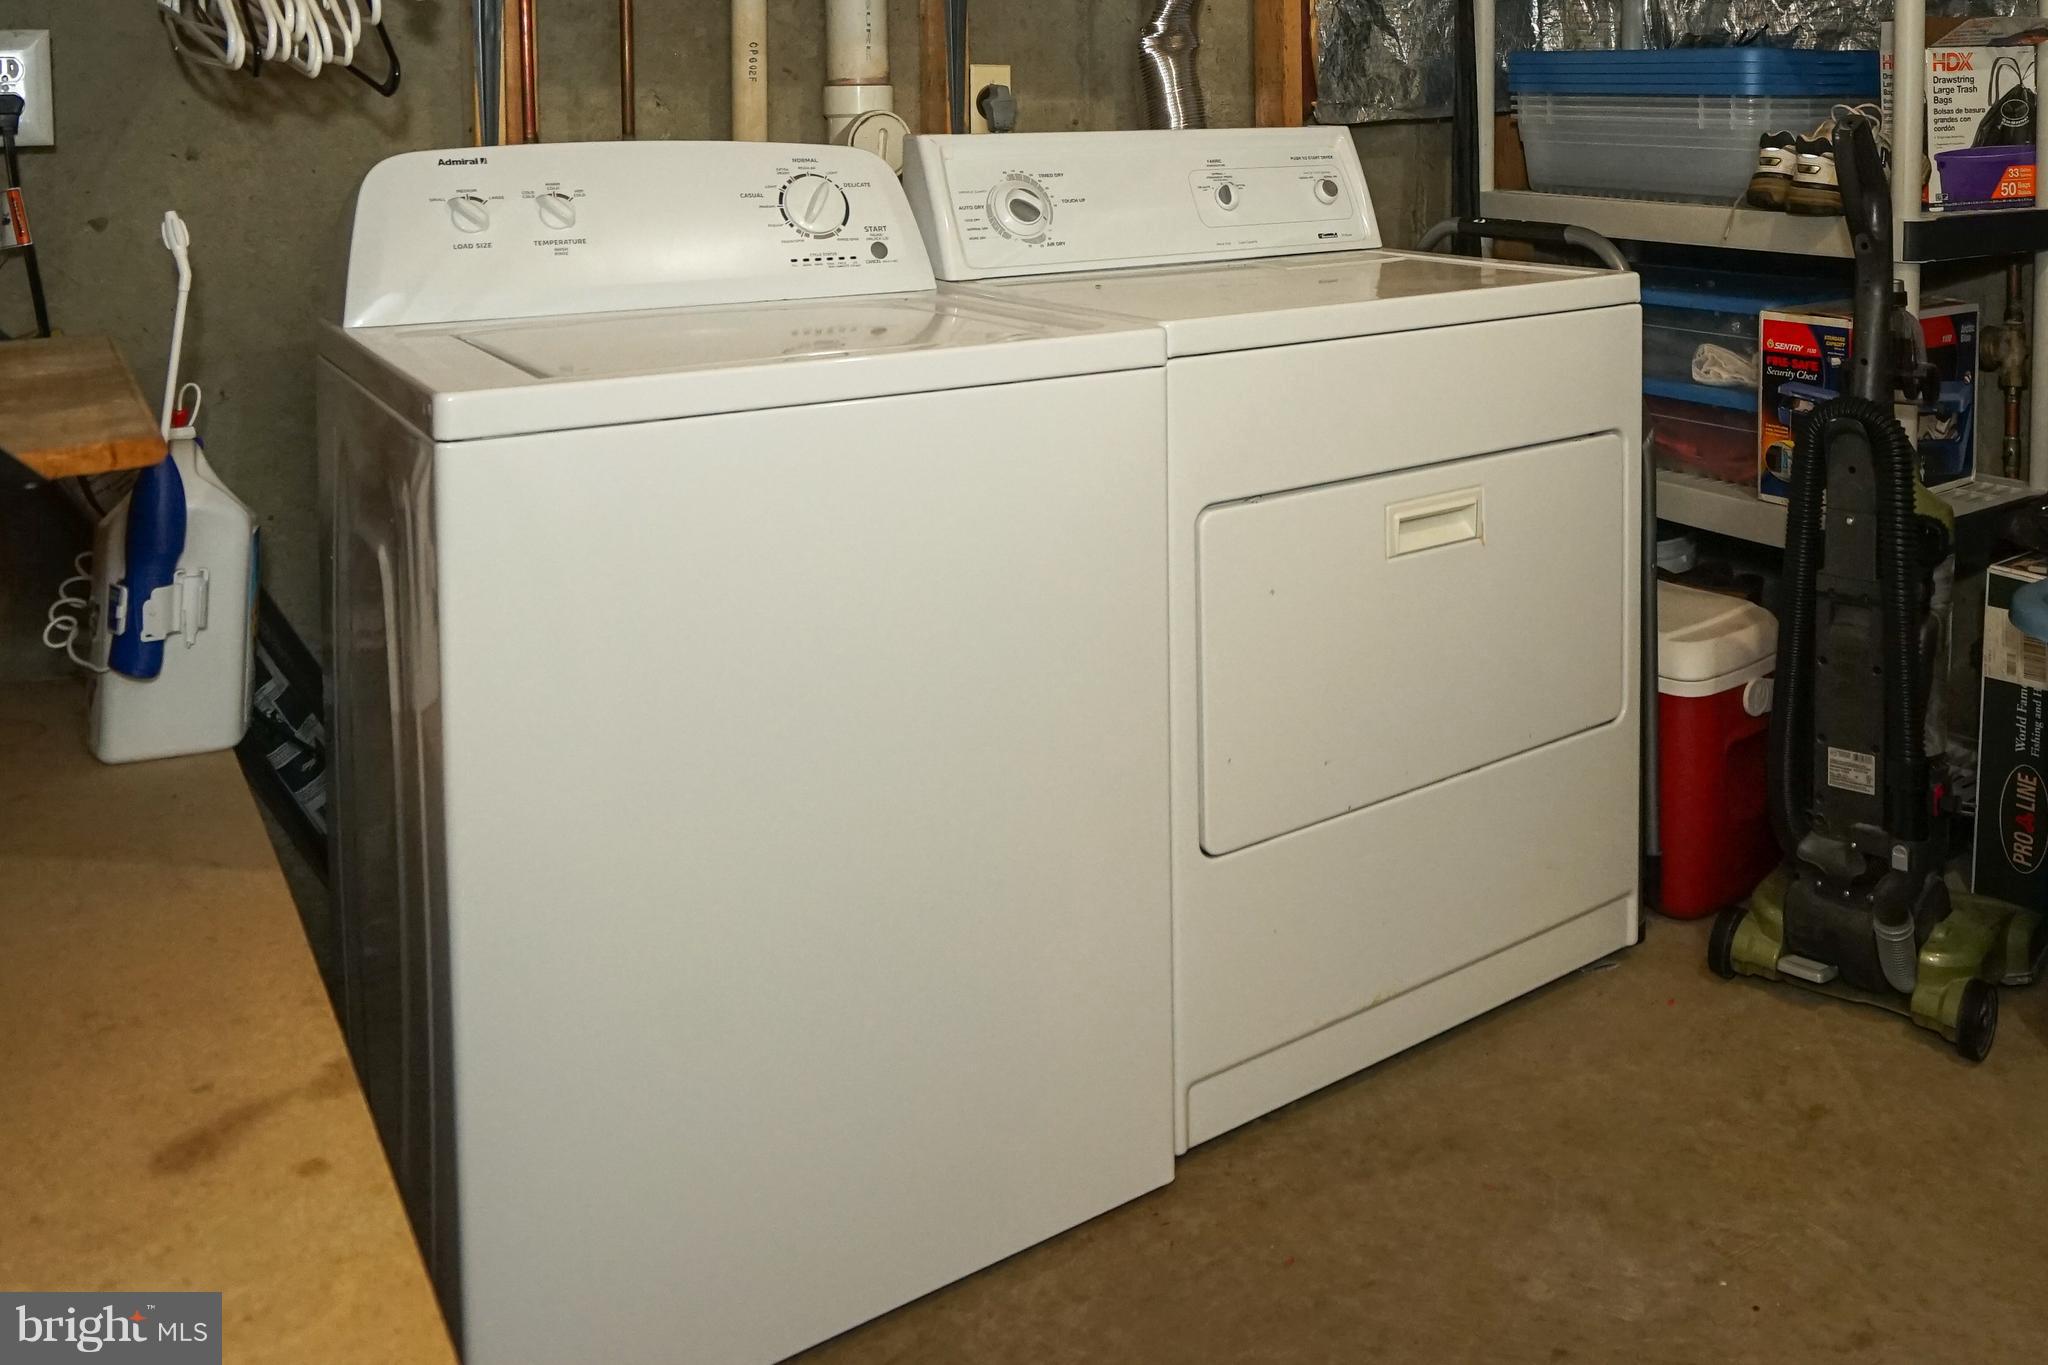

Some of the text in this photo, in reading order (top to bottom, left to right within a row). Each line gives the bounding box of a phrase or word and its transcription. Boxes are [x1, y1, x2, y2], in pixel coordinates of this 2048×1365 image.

[1932, 52, 1974, 71] HDX
[1932, 75, 1975, 85] Drawstring
[1933, 85, 1978, 96] Large Trash
[1933, 96, 1953, 106] Bags
[1933, 107, 1954, 115] Bolsas
[1964, 106, 1986, 114] basura
[1933, 116, 1958, 124] grandes
[1933, 124, 1956, 132] cordón
[438, 157, 479, 166] Admiral
[2008, 168, 2020, 178] 33
[2001, 182, 2017, 196] 50
[453, 242, 474, 250] LOAD
[533, 238, 587, 246] TEMPERATURE
[1773, 342, 1804, 352] SENTRY
[1766, 366, 1818, 381] Security Chest
[2032, 699, 2042, 719] and
[2015, 716, 2027, 752] World
[2030, 721, 2044, 758] Fishing
[2012, 772, 2038, 867] PRO LINE
